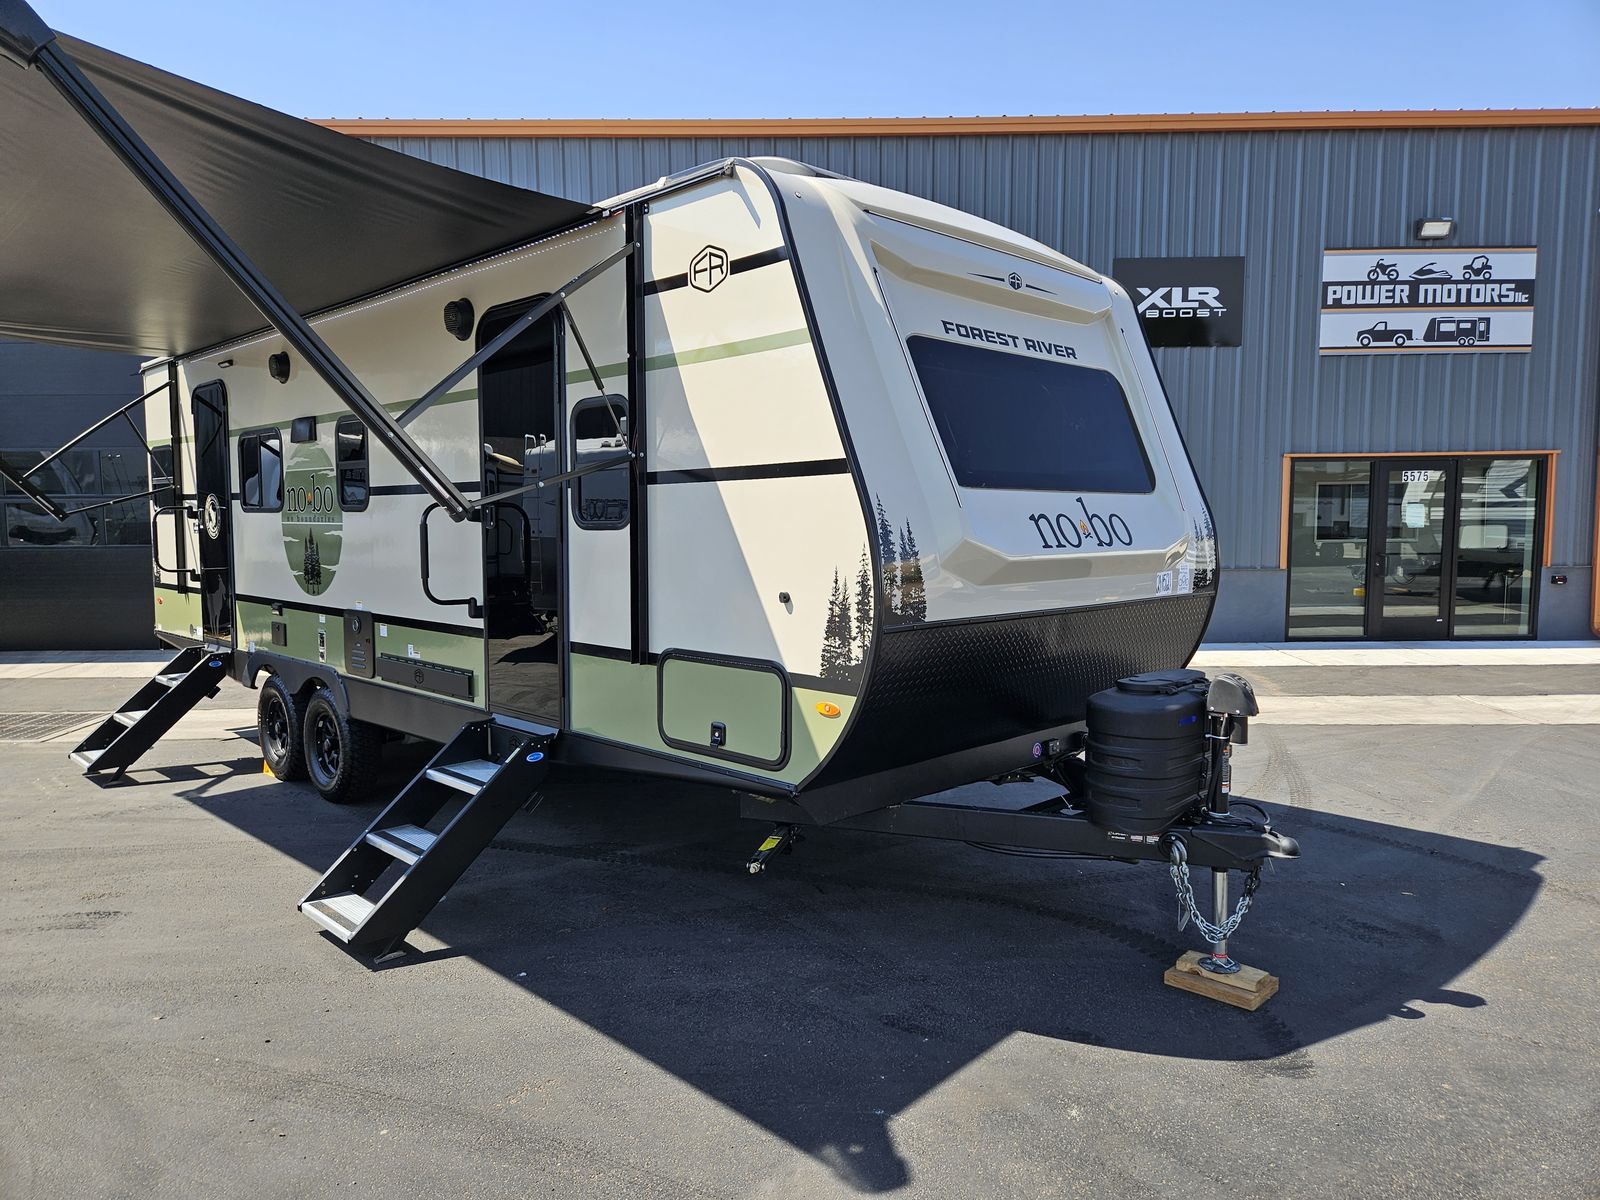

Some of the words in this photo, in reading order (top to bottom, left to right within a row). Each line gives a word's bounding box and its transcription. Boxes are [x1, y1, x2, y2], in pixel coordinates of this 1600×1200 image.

[1136, 286, 1223, 314] XLR
[1327, 285, 1409, 305] POWER
[1418, 284, 1515, 304] MOTORS
[1145, 308, 1227, 318] BOOST
[941, 319, 1019, 348] FOREST
[1023, 337, 1078, 360] RIVER
[1403, 471, 1429, 482] 5575
